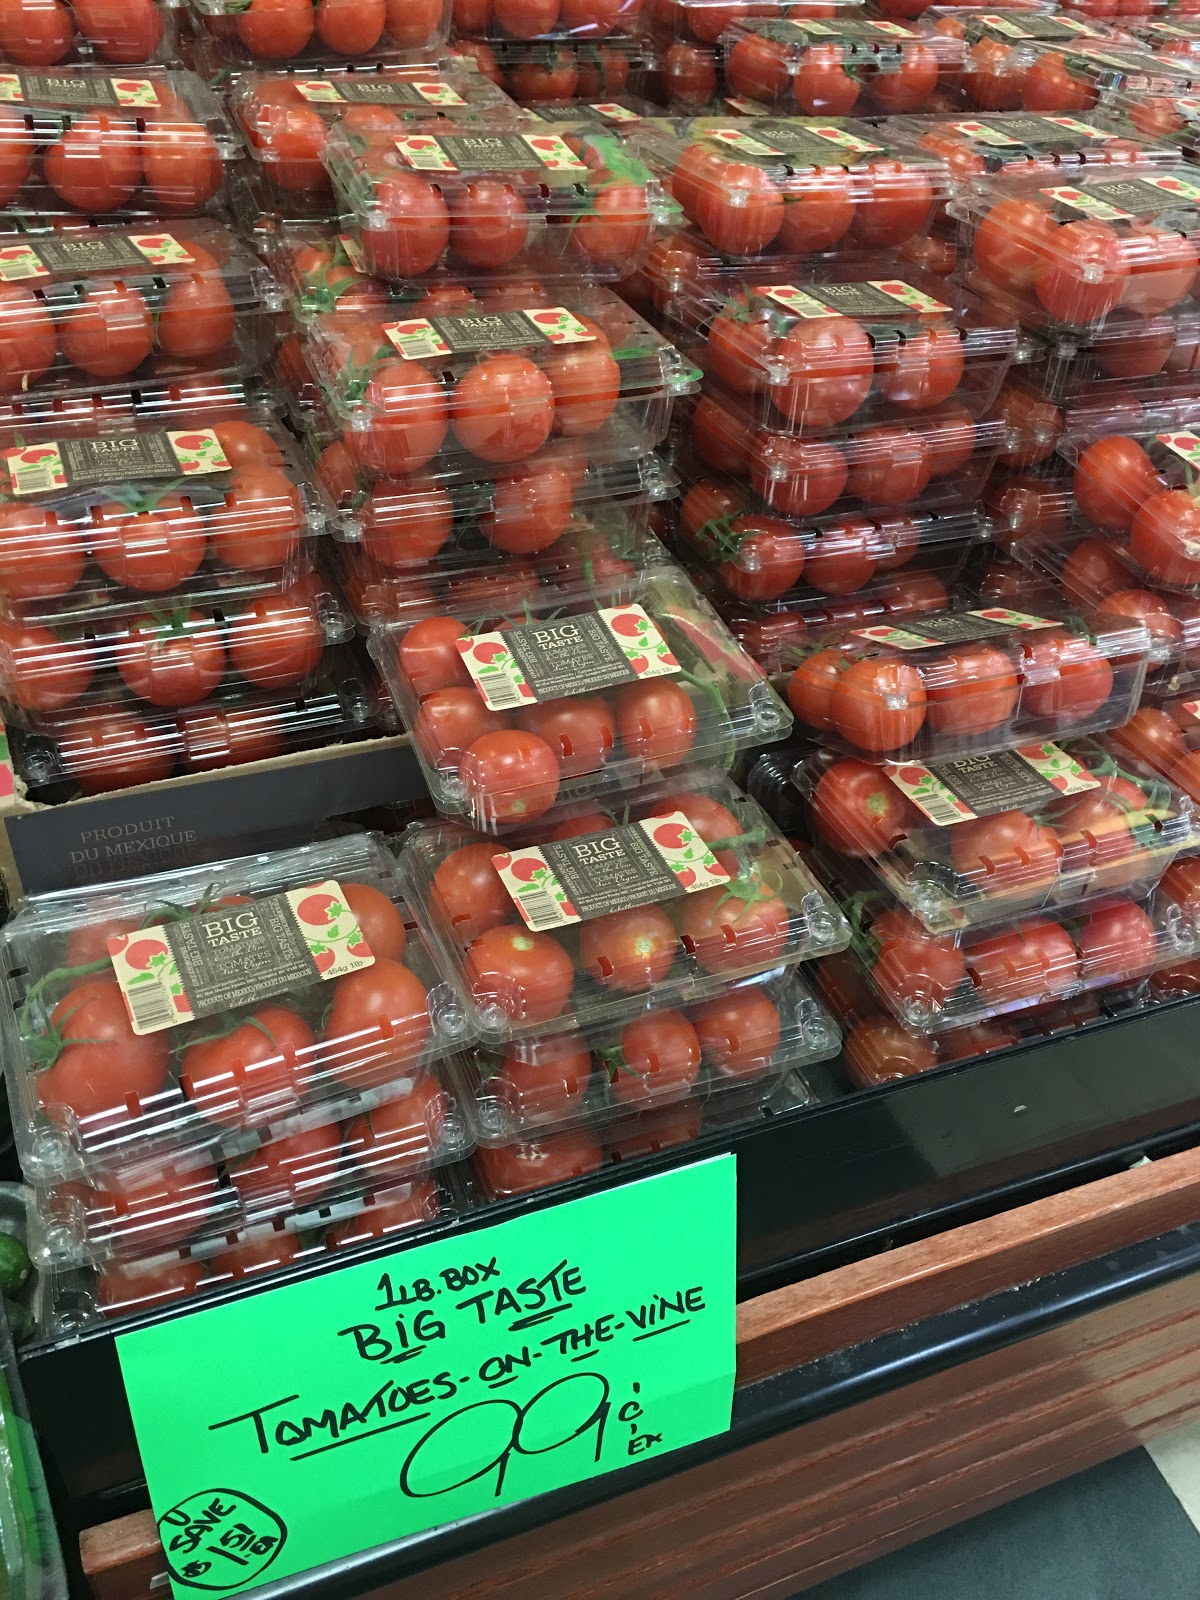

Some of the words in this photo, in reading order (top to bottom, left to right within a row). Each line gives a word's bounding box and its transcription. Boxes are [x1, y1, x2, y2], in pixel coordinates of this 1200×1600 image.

[461, 138, 502, 146] BIG
[60, 241, 105, 250] BIG
[456, 315, 501, 323] BIG
[89, 438, 139, 449] BIG
[513, 630, 531, 653] TASTE
[531, 624, 579, 644] BIG
[538, 635, 584, 651] TASTE
[587, 628, 601, 641] BIG
[594, 640, 614, 663] TASTE
[548, 653, 594, 668] TOMATES
[643, 668, 661, 676] 454g
[957, 760, 998, 774] TASTE
[80, 815, 175, 843] PRODUIT
[70, 850, 99, 864] DU
[105, 829, 197, 857] MEXIQUE
[551, 843, 572, 868] TASTE
[571, 836, 621, 859] BIG
[578, 848, 626, 865] TASTE
[629, 841, 644, 854] BIG
[638, 853, 659, 877] TASTE
[565, 866, 580, 880] BIG
[591, 867, 638, 884] TOMATES
[691, 881, 709, 890] 454g
[201, 911, 259, 939] BIG
[268, 916, 283, 933] BIG
[272, 898, 293, 938] GREENHOUSE
[178, 921, 198, 951] TASTE
[207, 926, 263, 948] TASTE
[275, 932, 295, 961] TASTE
[179, 945, 200, 987] GREENHOUSE
[189, 950, 204, 967] BIG
[216, 950, 272, 972] TOMATES
[327, 964, 349, 976] 454g
[196, 994, 224, 1008] PRODUCT
[223, 991, 232, 1000] OF
[277, 975, 288, 984] DU
[286, 967, 313, 981] MEXIQUE
[338, 1309, 446, 1364] BIG
[456, 1259, 586, 1331] TASTE
[400, 1372, 611, 1496] 99
[163, 1509, 191, 1526] U
[169, 1497, 237, 1554] SAVE
